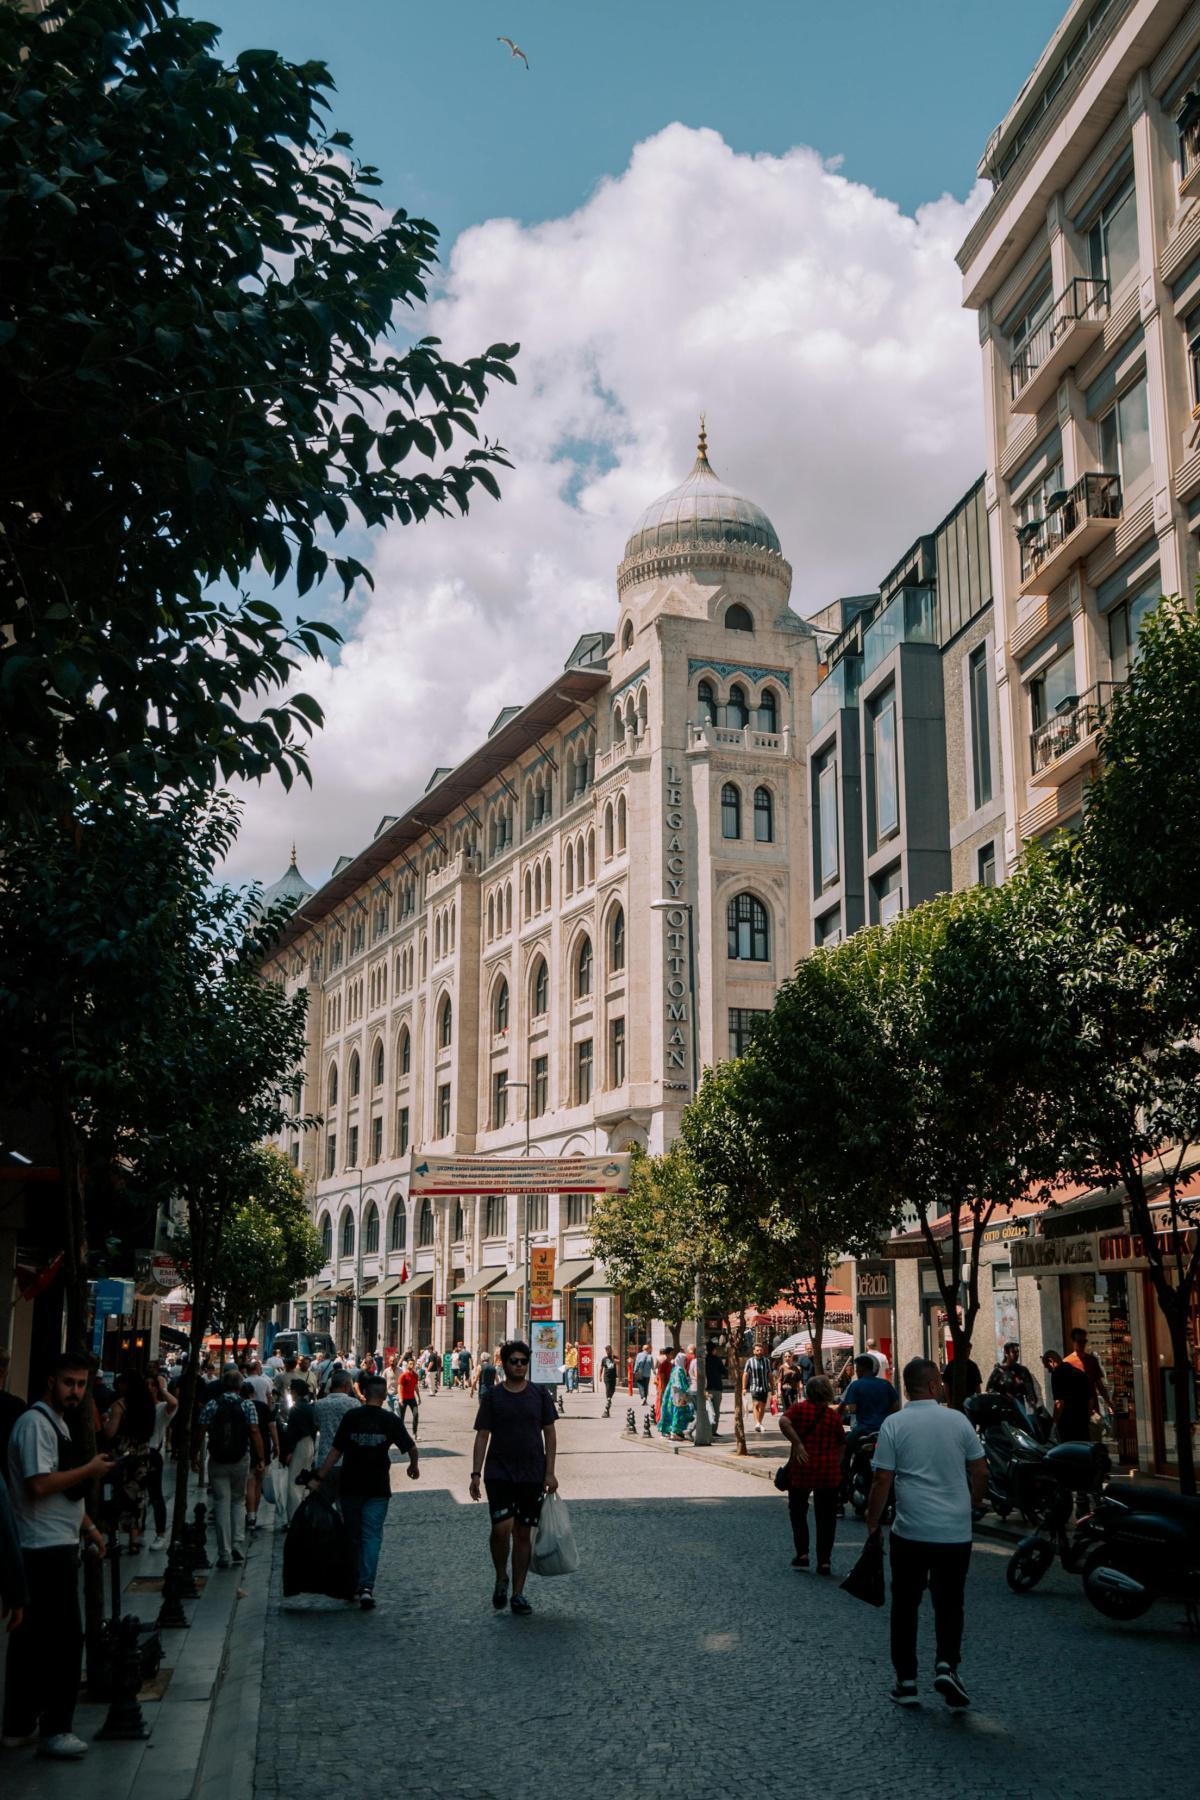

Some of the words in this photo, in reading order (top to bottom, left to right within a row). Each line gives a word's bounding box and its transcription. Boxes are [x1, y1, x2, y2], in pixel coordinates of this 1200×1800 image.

[666, 766, 685, 898] LEGACY
[666, 909, 688, 1070] OTTOMAN
[984, 1230, 1000, 1242] OTTO
[1099, 1234, 1131, 1261] OTTO
